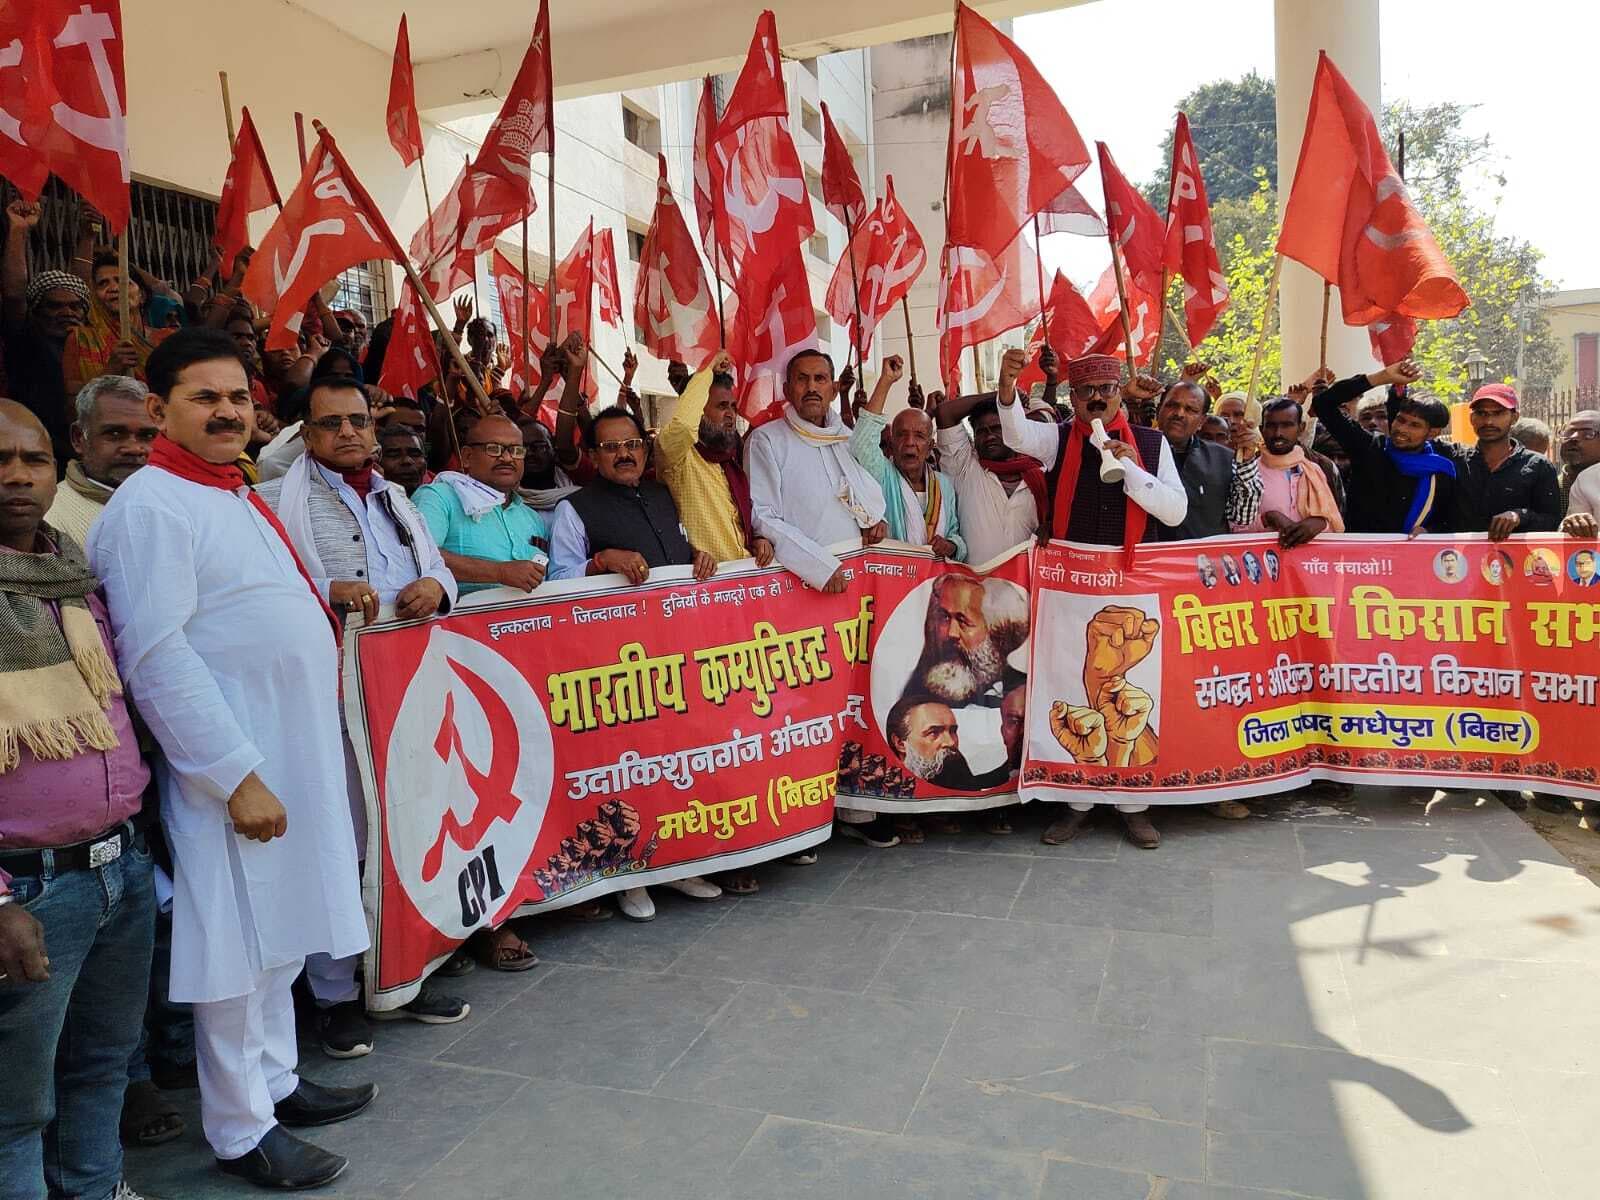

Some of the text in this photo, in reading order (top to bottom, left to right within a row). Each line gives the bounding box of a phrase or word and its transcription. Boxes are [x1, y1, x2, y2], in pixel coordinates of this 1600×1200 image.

[1070, 569, 1123, 587] बचाओ!
[1301, 556, 1329, 575] गाँव
[488, 615, 553, 641] इन्कलाब
[572, 603, 637, 625] जिन्दाबाद
[700, 588, 711, 606] के
[749, 585, 766, 600] एक
[769, 578, 782, 598] हो
[1172, 593, 1260, 655] बिहार
[1261, 597, 1336, 642] राज्य
[1349, 585, 1511, 644] किसान
[547, 643, 687, 733] भारतीय
[693, 621, 834, 717] कम्युनिस्ट
[1194, 664, 1253, 709] संबद्ध
[1318, 652, 1425, 694] भारतीय
[1429, 654, 1525, 699] किसान
[1530, 671, 1600, 706] सभा
[564, 714, 834, 800] उदाकिशुनगंज अंचल
[1243, 717, 1290, 747] जिला
[1340, 710, 1435, 747] मधेपुरा
[1445, 711, 1533, 750] (बिहार)
[656, 769, 838, 840] मधेपुरा (बिहार
[457, 844, 506, 928] CPI
